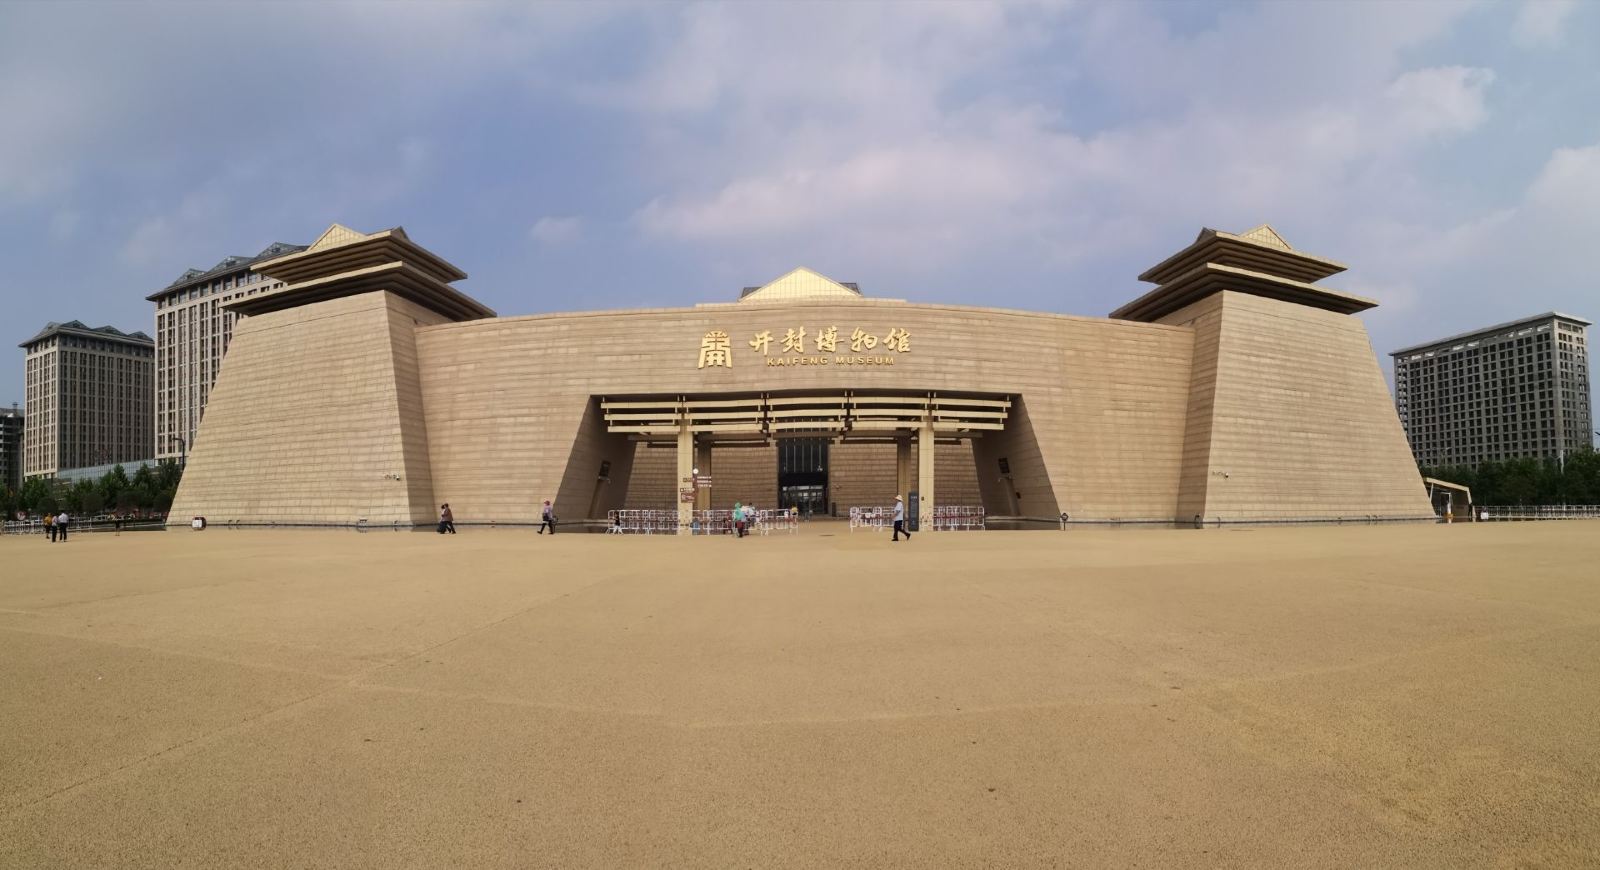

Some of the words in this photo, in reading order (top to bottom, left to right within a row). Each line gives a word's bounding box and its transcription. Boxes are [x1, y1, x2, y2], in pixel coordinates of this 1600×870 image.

[749, 326, 911, 356] 开封博物馆
[767, 357, 828, 367] KAIFENG
[835, 356, 895, 366] MUSEUM
